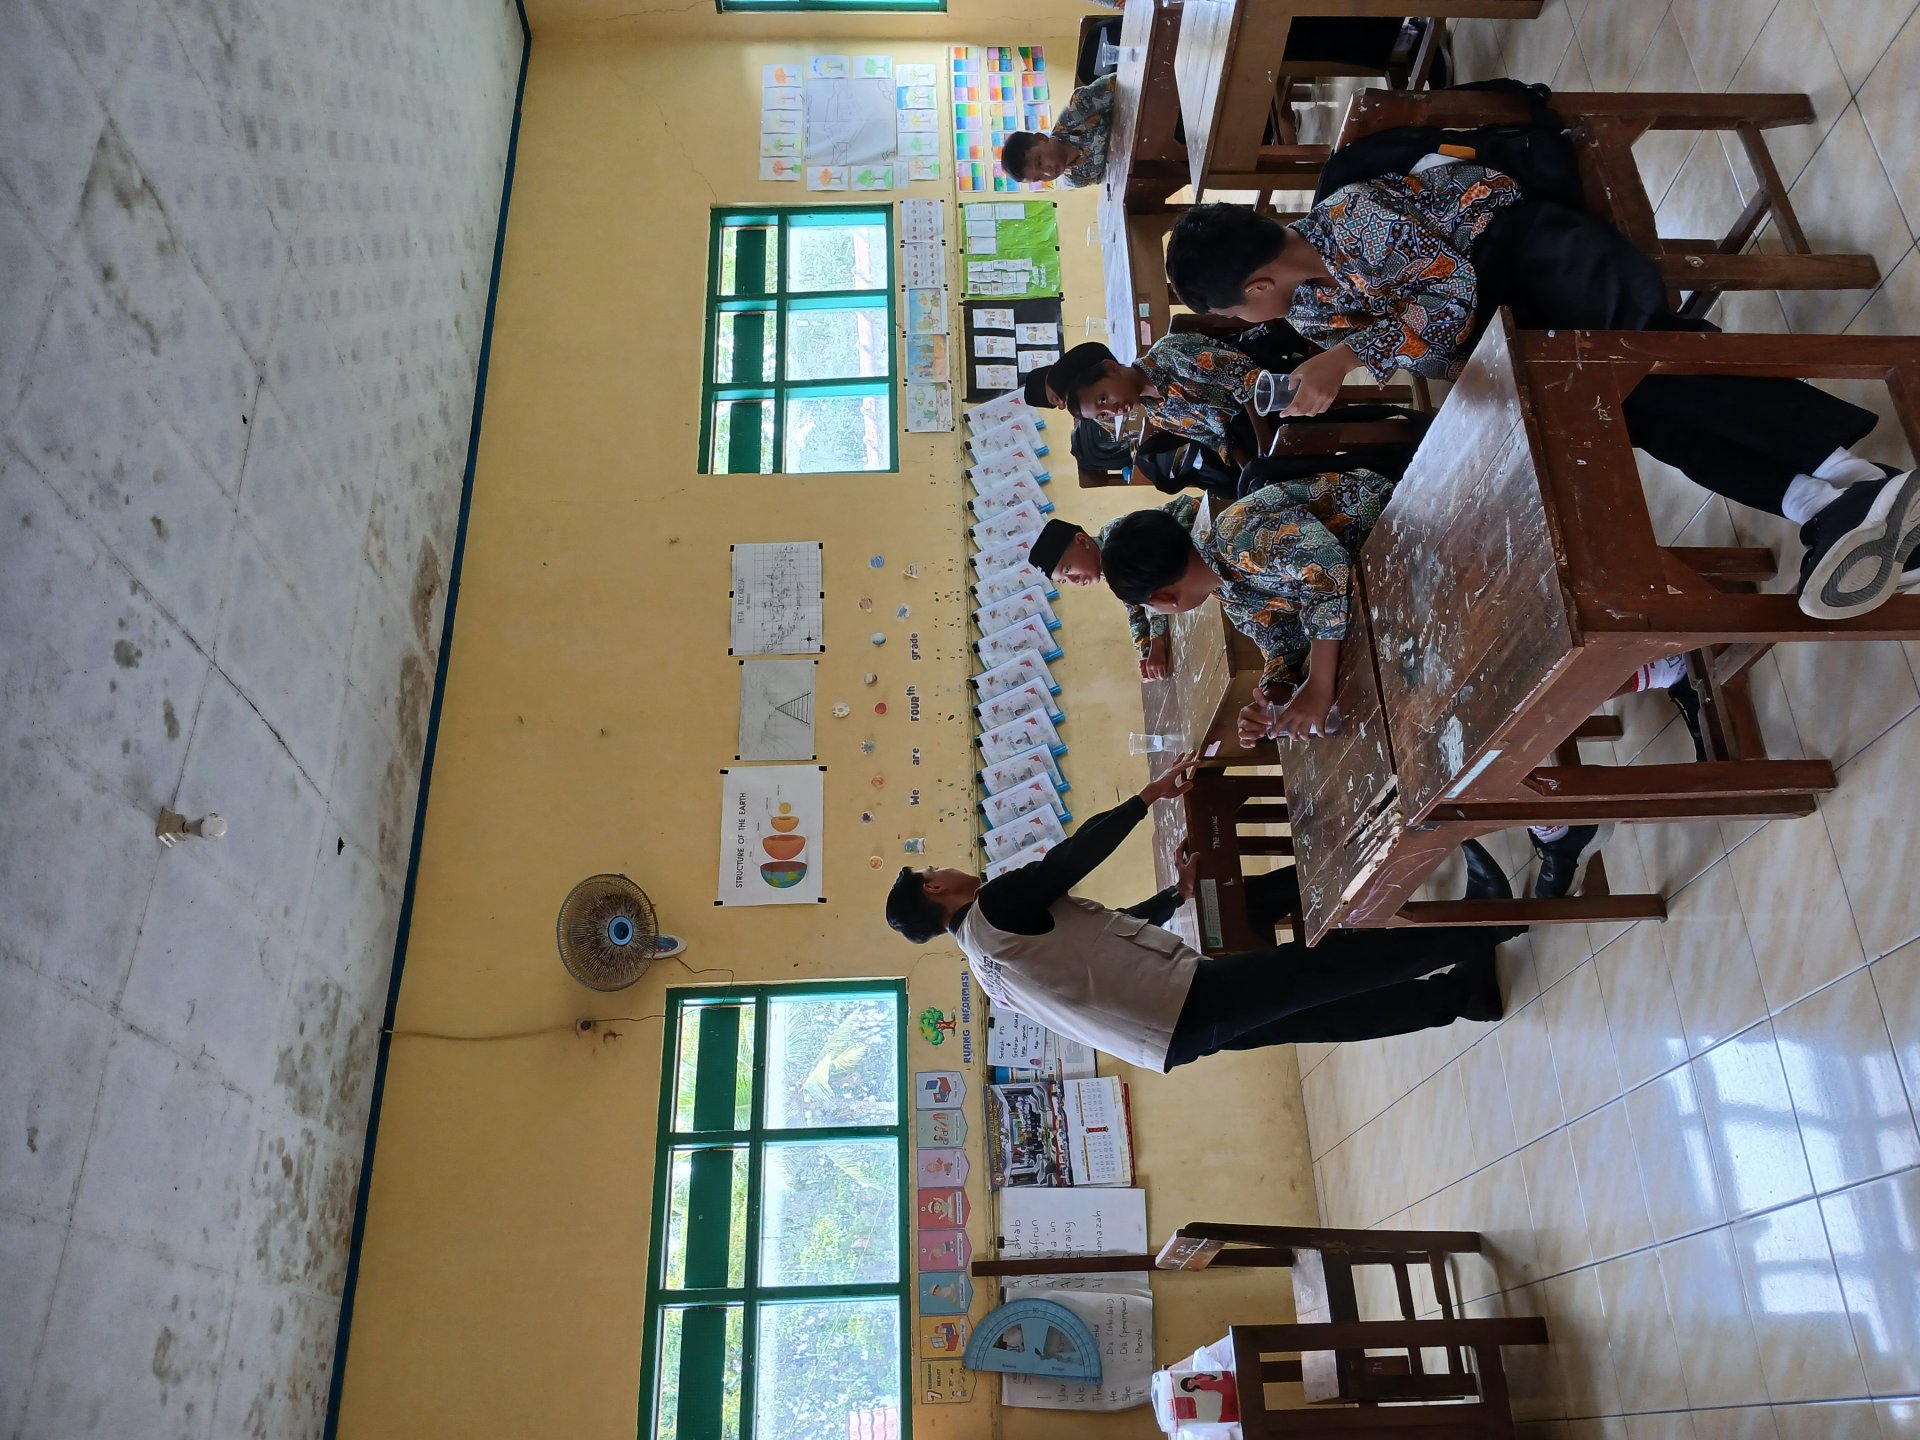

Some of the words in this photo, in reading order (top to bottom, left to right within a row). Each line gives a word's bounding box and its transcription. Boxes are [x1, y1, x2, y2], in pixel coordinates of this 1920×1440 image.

[908, 632, 920, 660] grade
[912, 748, 920, 766] are
[738, 792, 748, 815] EARTH
[910, 789, 920, 806] We
[738, 818, 747, 831] THE
[737, 834, 746, 845] OF
[735, 848, 746, 889] STRUCTURE
[960, 971, 970, 1023] INFORMASI
[962, 1029, 972, 1064] RUANG
[1028, 1219, 1044, 1258] Kafirun
[926, 1390, 942, 1402] 7
